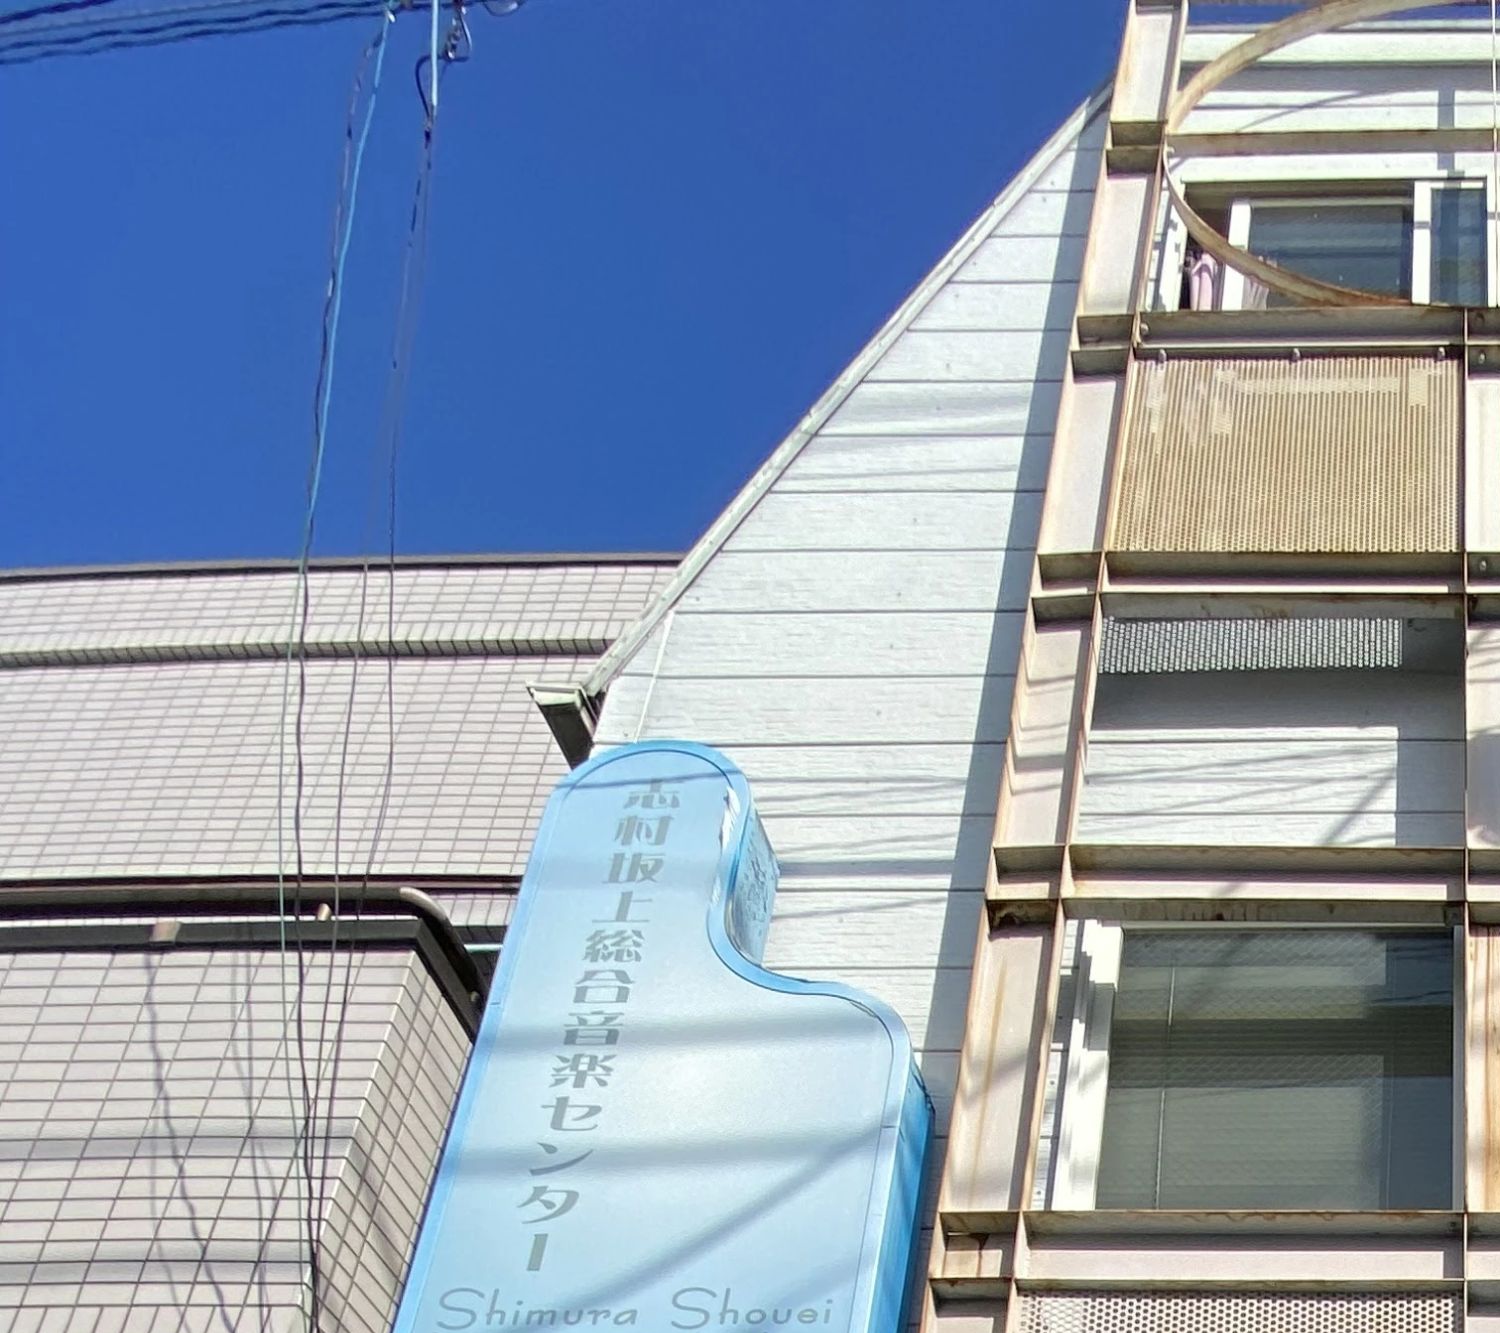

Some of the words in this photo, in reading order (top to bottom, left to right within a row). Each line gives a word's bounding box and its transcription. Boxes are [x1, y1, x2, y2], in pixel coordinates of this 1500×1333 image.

[516, 777, 682, 1272] 志村坂上総合音楽センター
[436, 1286, 638, 1331] Shimura
[670, 1286, 835, 1331] Shouei
